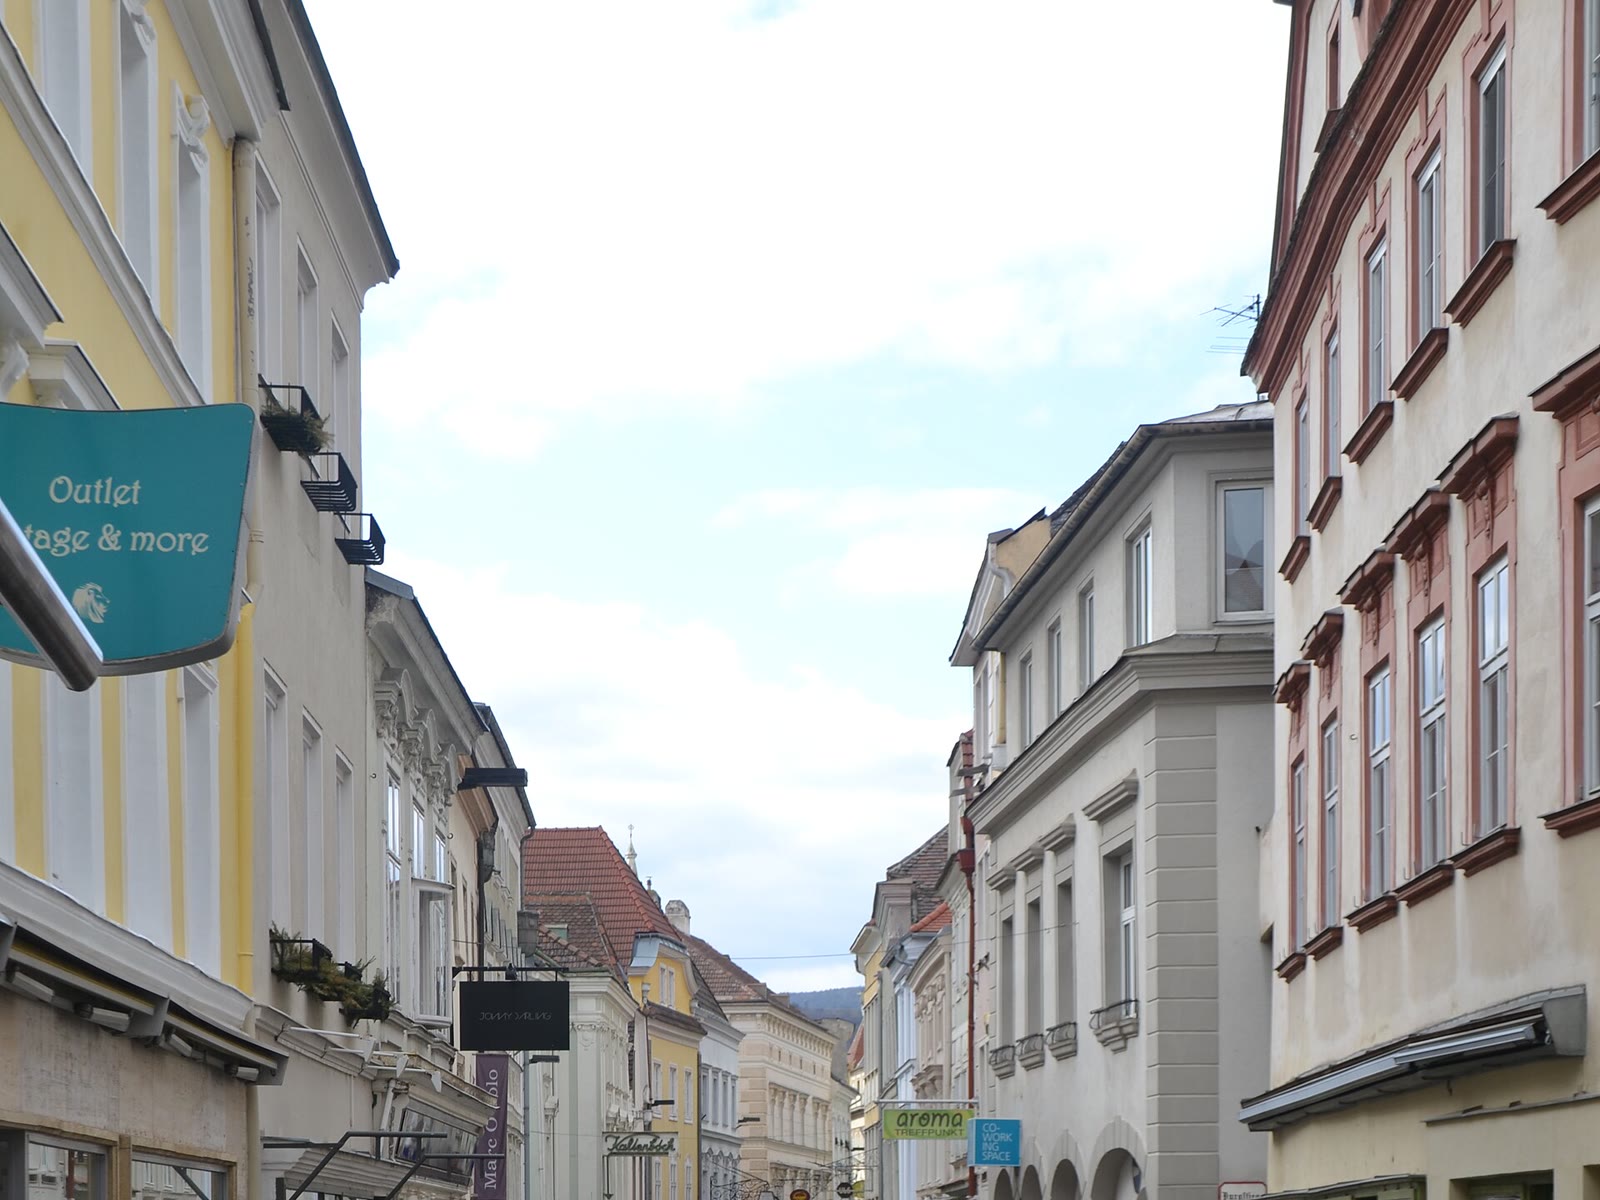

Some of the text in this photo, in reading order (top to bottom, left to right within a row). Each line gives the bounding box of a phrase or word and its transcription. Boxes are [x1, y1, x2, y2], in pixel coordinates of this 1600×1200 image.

[48, 475, 142, 508] Outlet
[97, 523, 123, 552] &
[129, 531, 209, 556] more
[896, 1111, 963, 1128] aroma
[894, 1128, 965, 1137] TREFFPUNKT
[982, 1133, 1013, 1142] WORK
[981, 1151, 1011, 1161] SPACE
